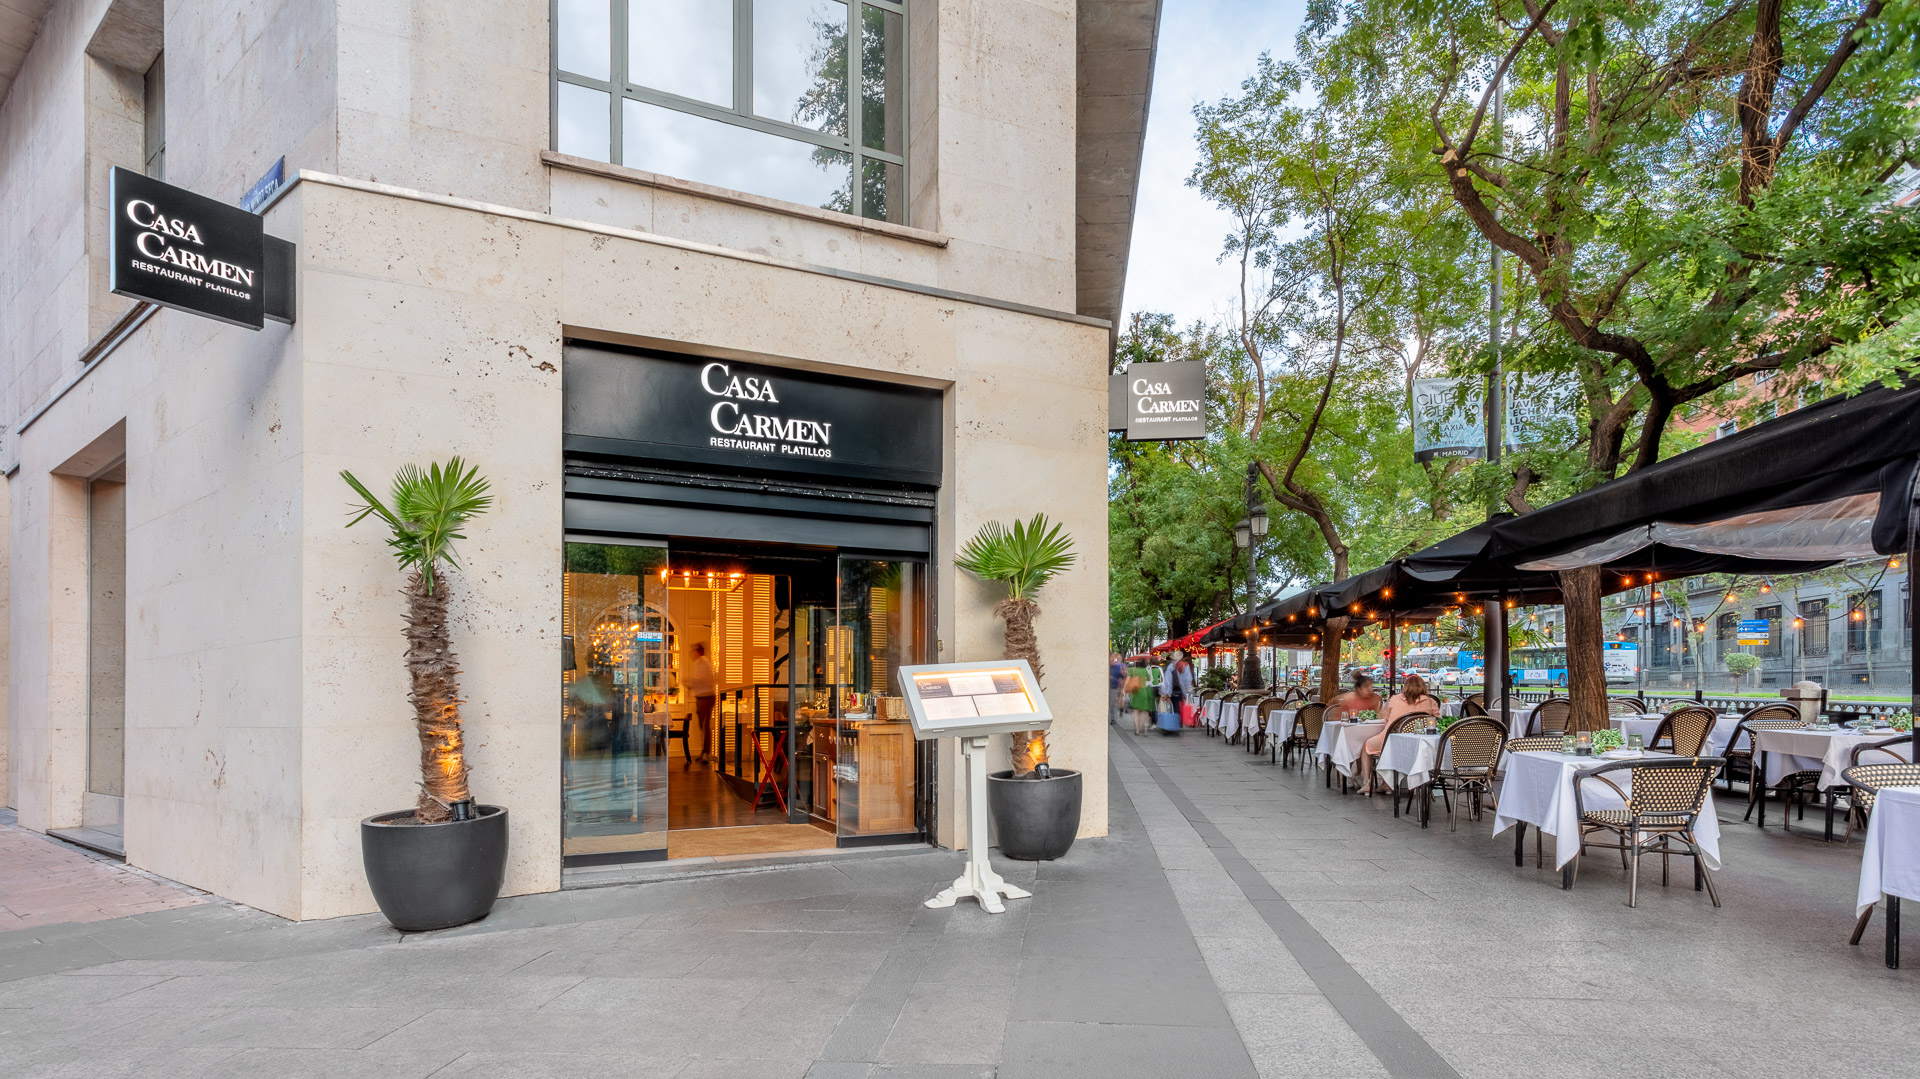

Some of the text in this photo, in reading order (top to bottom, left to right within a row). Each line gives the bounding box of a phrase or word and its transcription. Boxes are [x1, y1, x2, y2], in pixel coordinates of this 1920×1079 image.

[126, 199, 205, 246] CASA
[136, 231, 255, 287] CARMEN
[131, 259, 251, 301] RESTAURANT PLATILLOS
[700, 362, 780, 403] CASA
[1132, 378, 1172, 395] CASA
[710, 401, 832, 445] CARMEN
[1137, 396, 1200, 414] CARMEN
[710, 437, 832, 458] RESTAURANT PLATILLOS
